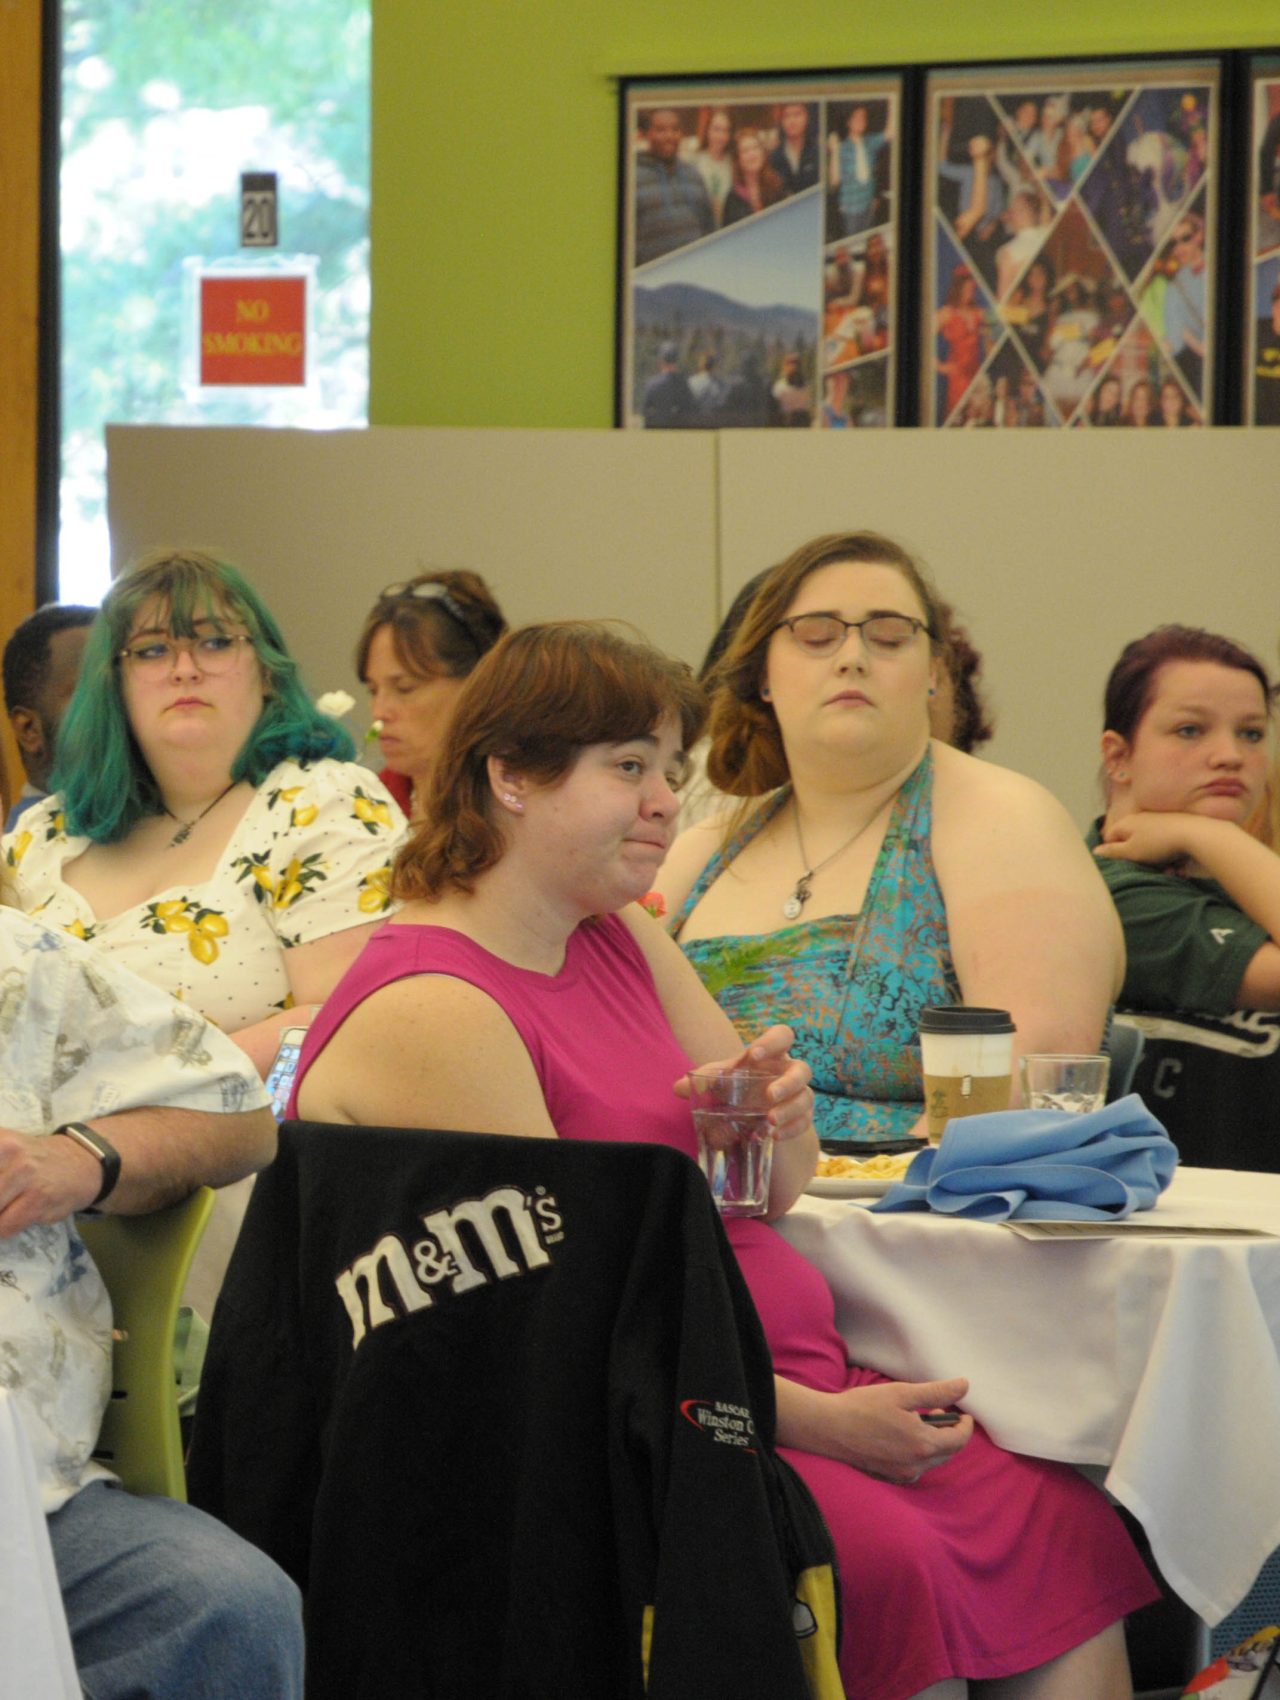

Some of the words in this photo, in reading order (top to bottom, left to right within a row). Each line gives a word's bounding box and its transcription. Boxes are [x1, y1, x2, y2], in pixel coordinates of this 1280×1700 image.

[235, 299, 270, 321] NO
[204, 331, 302, 355] SMOKING
[697, 1408, 744, 1432] Winston
[713, 1428, 750, 1446] Series
